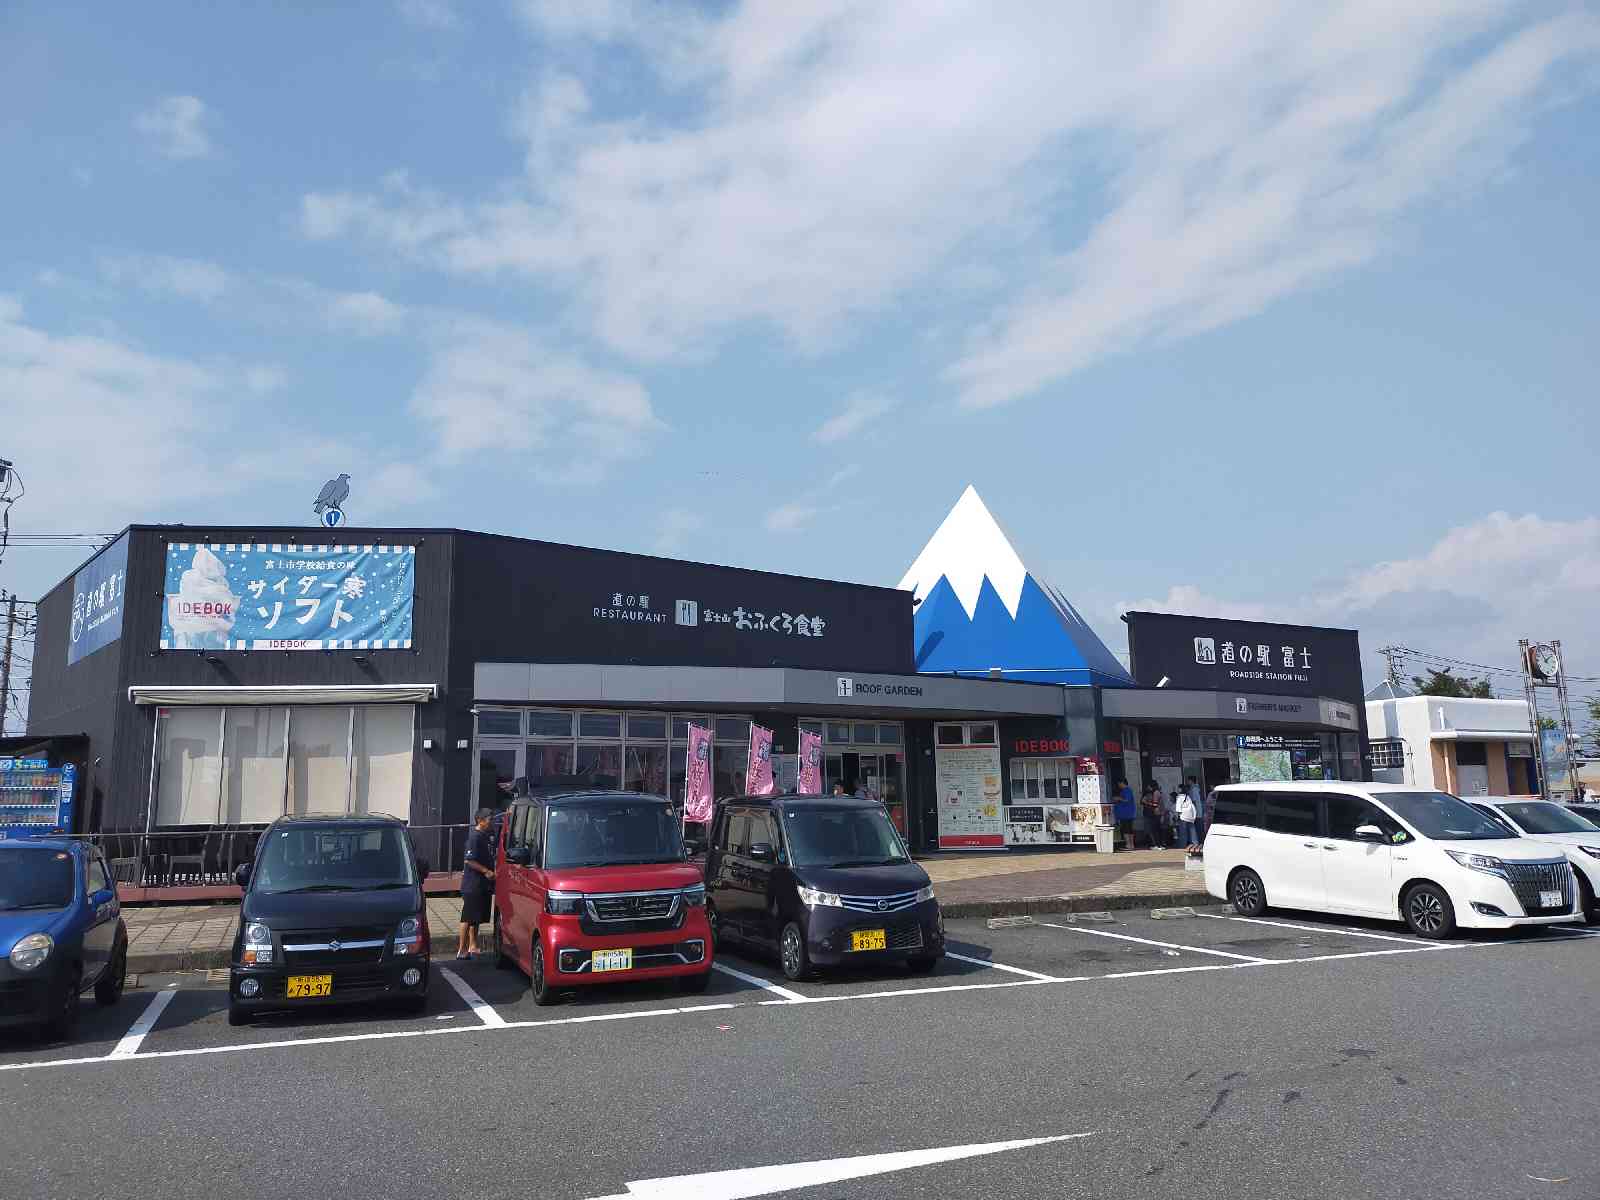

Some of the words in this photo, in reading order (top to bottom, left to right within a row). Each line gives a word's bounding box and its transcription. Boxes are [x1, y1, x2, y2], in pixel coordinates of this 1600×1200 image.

[612, 592, 650, 609] 道の駅
[178, 602, 232, 615] IDEBOK
[256, 599, 353, 630] ソフト
[593, 607, 667, 624] RESTAURANT
[269, 640, 308, 649] IDEBOK
[1220, 641, 1271, 667] 道の駅
[1281, 646, 1312, 669] 富士
[1229, 670, 1263, 680] ROADSIDE
[856, 683, 882, 695] ROOF
[884, 685, 923, 697] GARDEN
